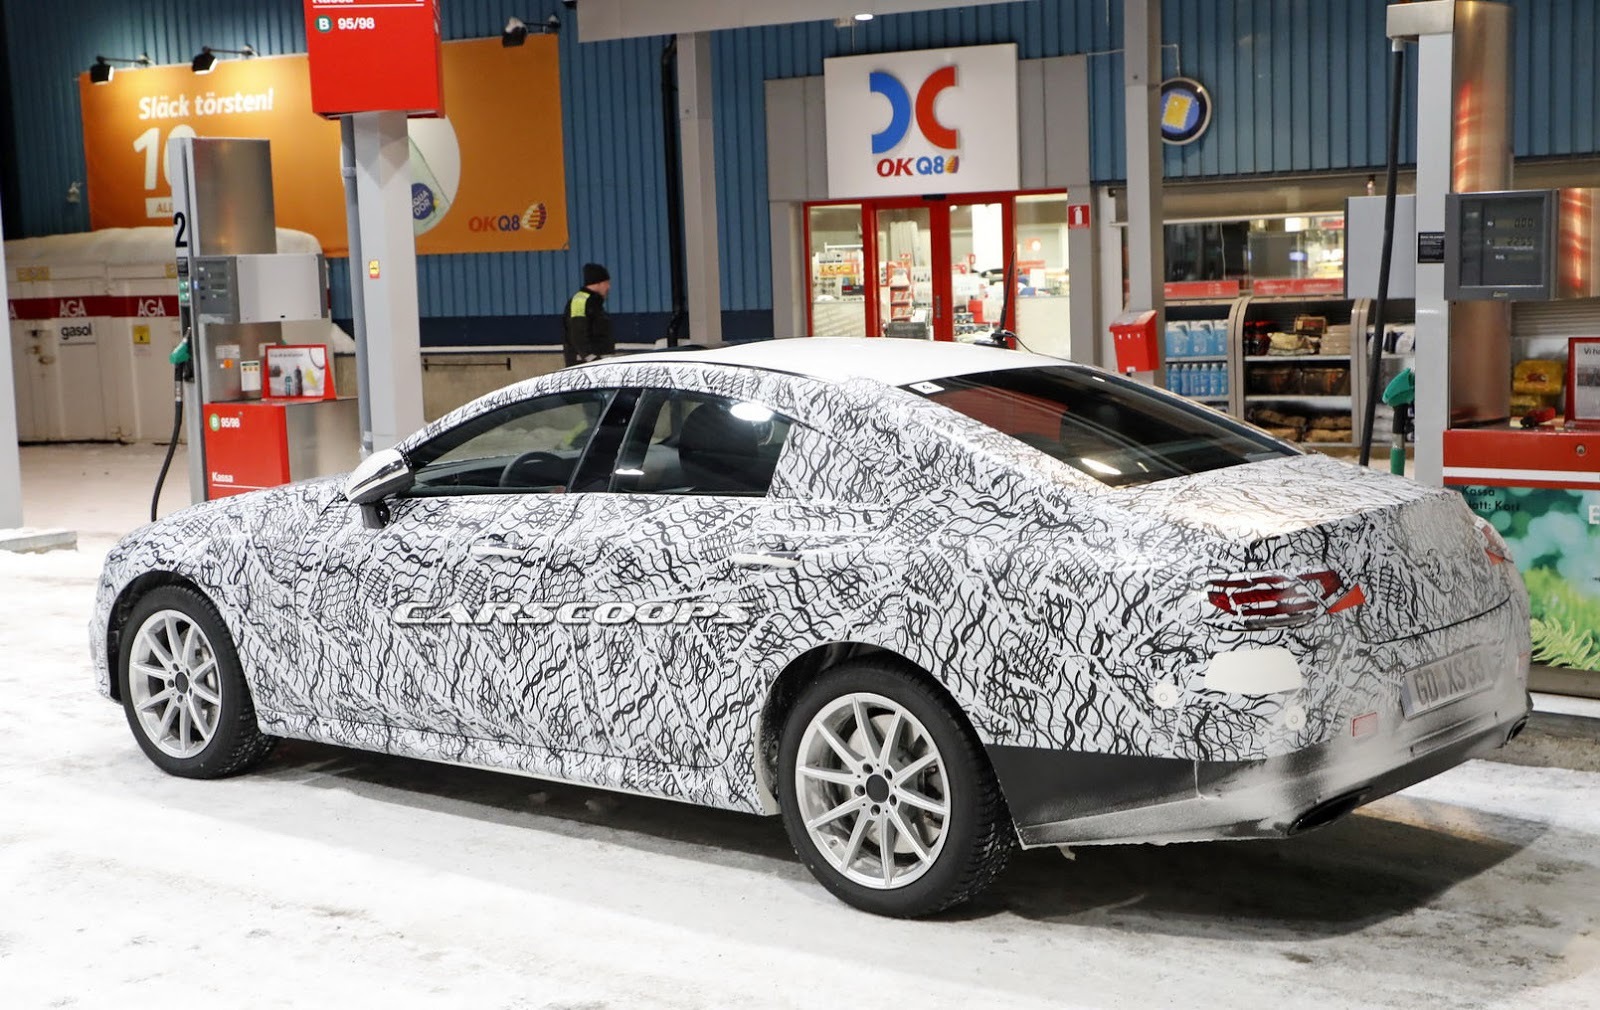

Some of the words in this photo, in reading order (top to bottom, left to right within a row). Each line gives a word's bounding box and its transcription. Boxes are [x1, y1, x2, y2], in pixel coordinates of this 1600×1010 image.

[337, 17, 375, 30] 95/98
[138, 94, 190, 120] Släck
[194, 87, 274, 116] törsten!
[173, 211, 188, 248] 2
[59, 299, 87, 317] AGA
[137, 298, 166, 317] AGA
[60, 323, 92, 340] gasol
[211, 471, 234, 483] Kassa
[1461, 485, 1496, 497] Kassa
